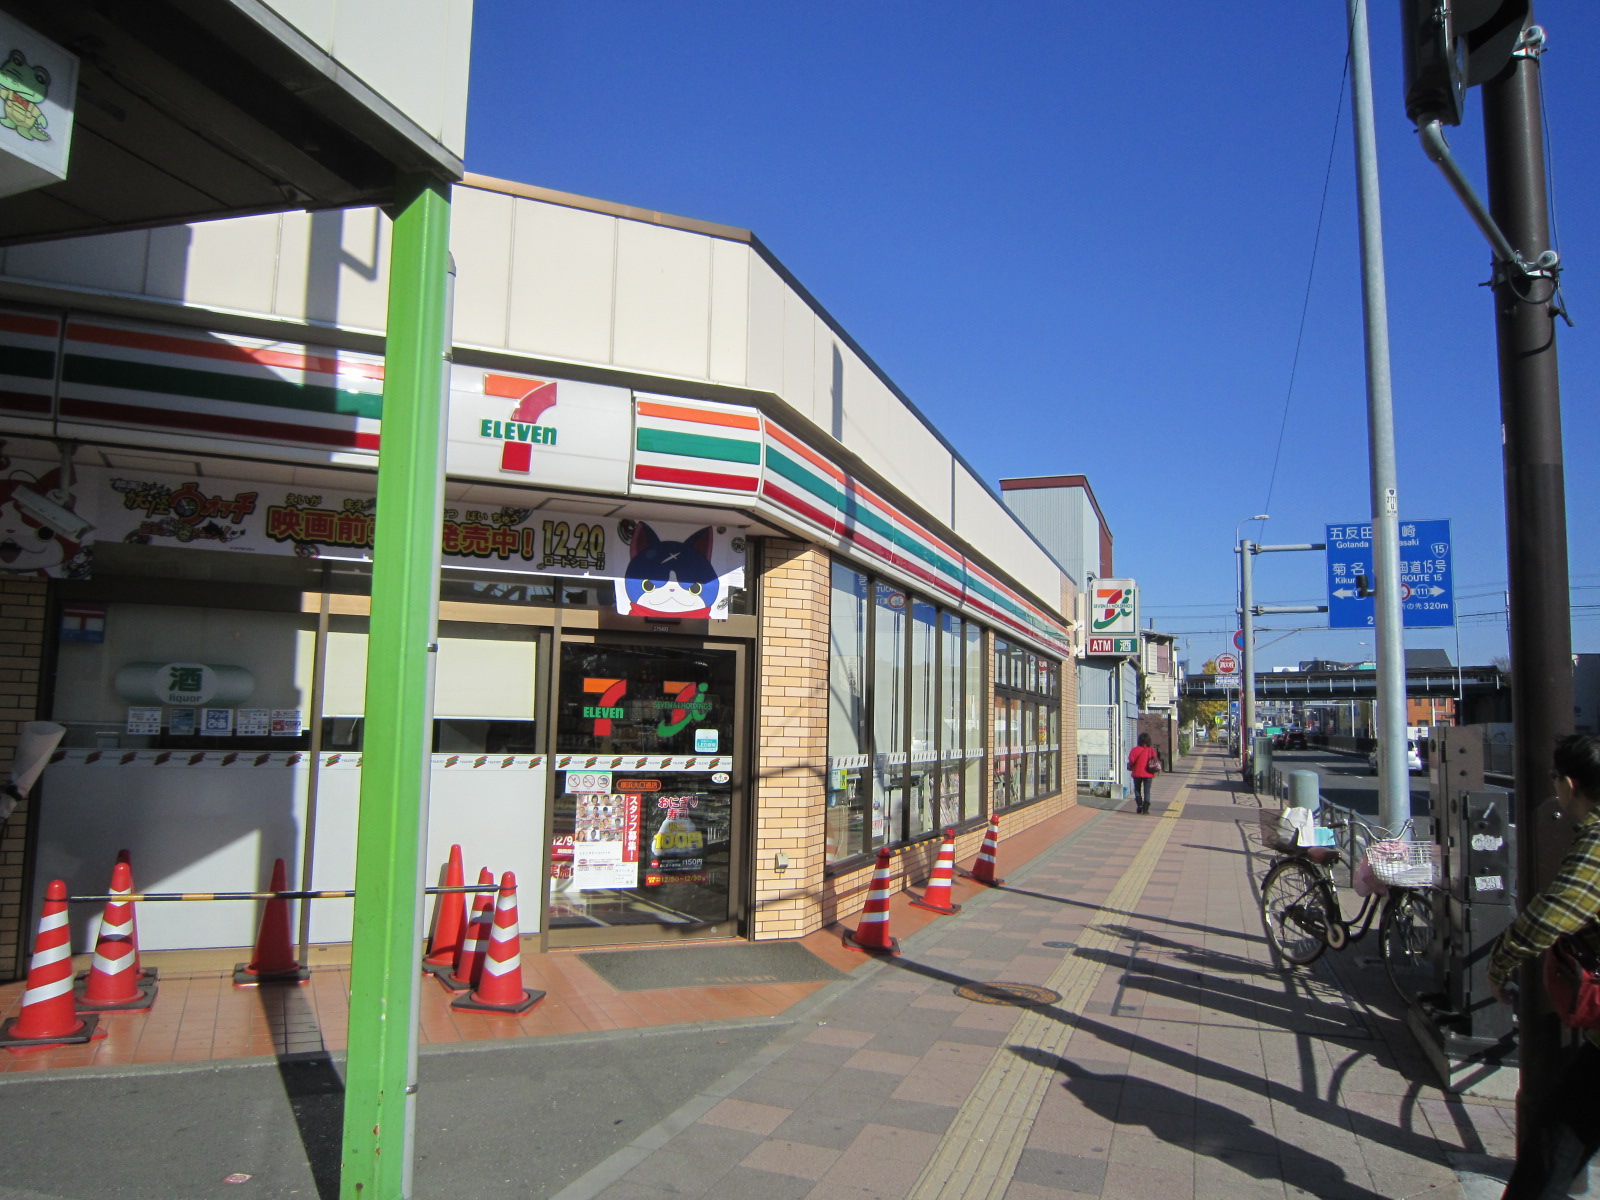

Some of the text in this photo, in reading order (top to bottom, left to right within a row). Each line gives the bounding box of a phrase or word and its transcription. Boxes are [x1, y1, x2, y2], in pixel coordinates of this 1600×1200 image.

[1330, 526, 1373, 541] 五反田
[543, 520, 605, 560] 12.20
[1336, 540, 1369, 549] Gotanda
[1434, 544, 1445, 554] 15
[1332, 562, 1365, 576] 菊名
[1401, 574, 1430, 582] ROUTE
[1433, 573, 1442, 582] 15
[1417, 588, 1428, 596] 111
[1424, 601, 1449, 610] 320m
[1092, 640, 1111, 652] ATM
[1119, 640, 1132, 652] 酒
[169, 667, 203, 692] 酒
[169, 694, 202, 703] liquor
[657, 796, 700, 809] おにぎり
[666, 807, 689, 820] 寿司
[653, 831, 703, 850] 100円
